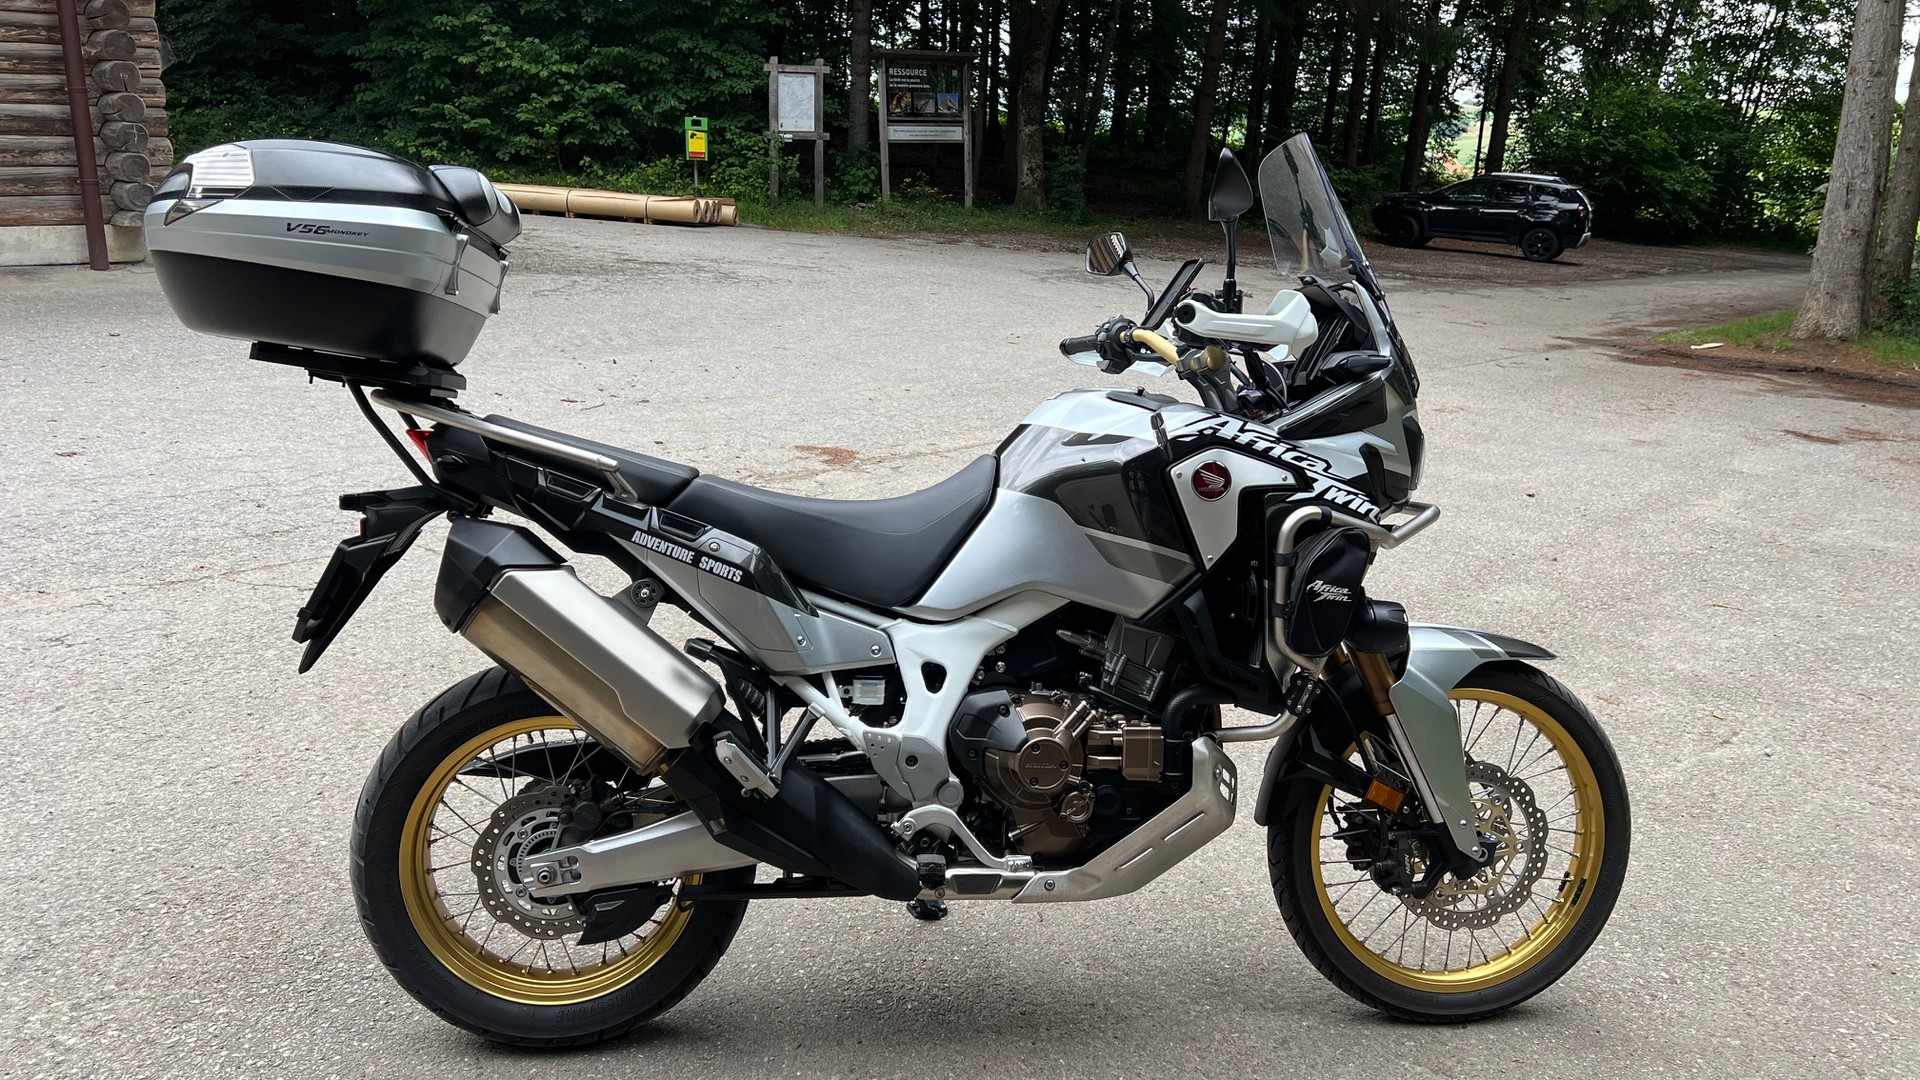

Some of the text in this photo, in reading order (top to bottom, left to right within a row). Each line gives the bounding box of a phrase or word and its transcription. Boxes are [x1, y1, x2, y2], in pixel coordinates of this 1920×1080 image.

[889, 68, 927, 76] RESSOURCE
[286, 222, 370, 237] V56 MONOKEY
[1177, 413, 1348, 481] Africa
[1285, 469, 1381, 525] Twin
[631, 530, 743, 583] ADVENTURE SPORTS
[1306, 579, 1352, 594] Africa
[1313, 591, 1352, 602] Twin
